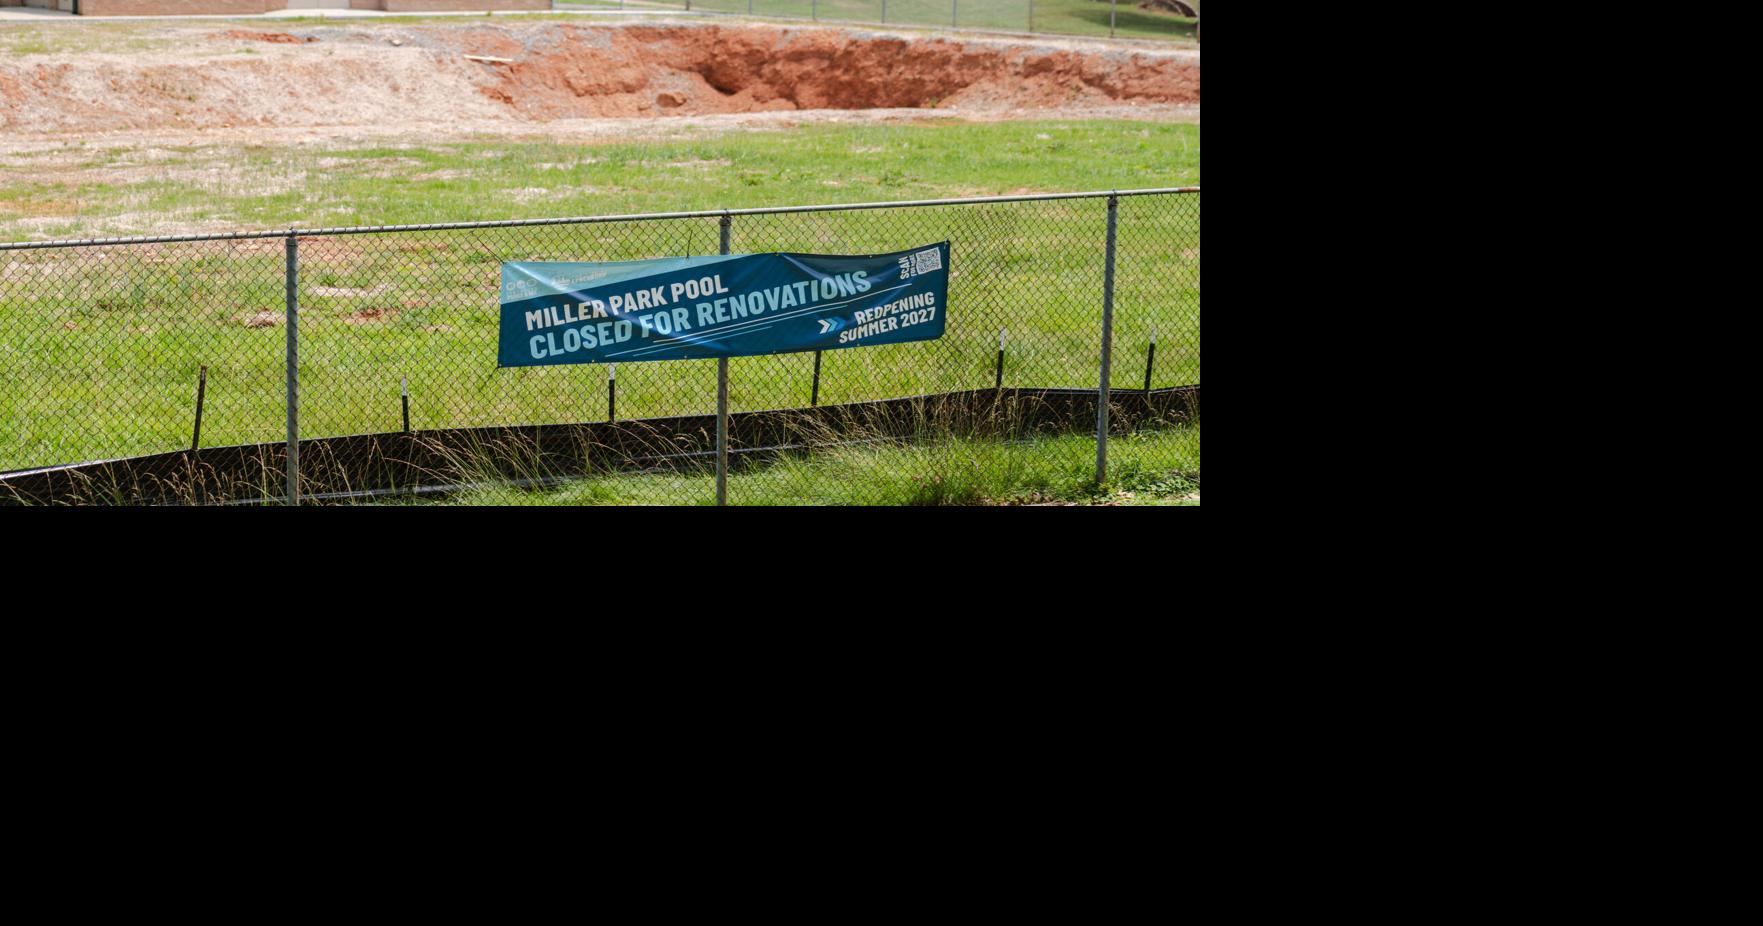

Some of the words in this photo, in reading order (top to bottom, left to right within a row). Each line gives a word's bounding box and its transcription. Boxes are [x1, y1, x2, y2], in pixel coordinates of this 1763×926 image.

[898, 256, 910, 279] SCAN
[525, 299, 609, 331] MILLER
[609, 285, 668, 316] PARK
[670, 274, 729, 303] POOL
[529, 319, 633, 359] CLOSED
[639, 307, 692, 338] FOR
[696, 270, 872, 327] RENOVATIONS
[839, 316, 898, 344] SUMMER
[900, 306, 936, 328] 2027
